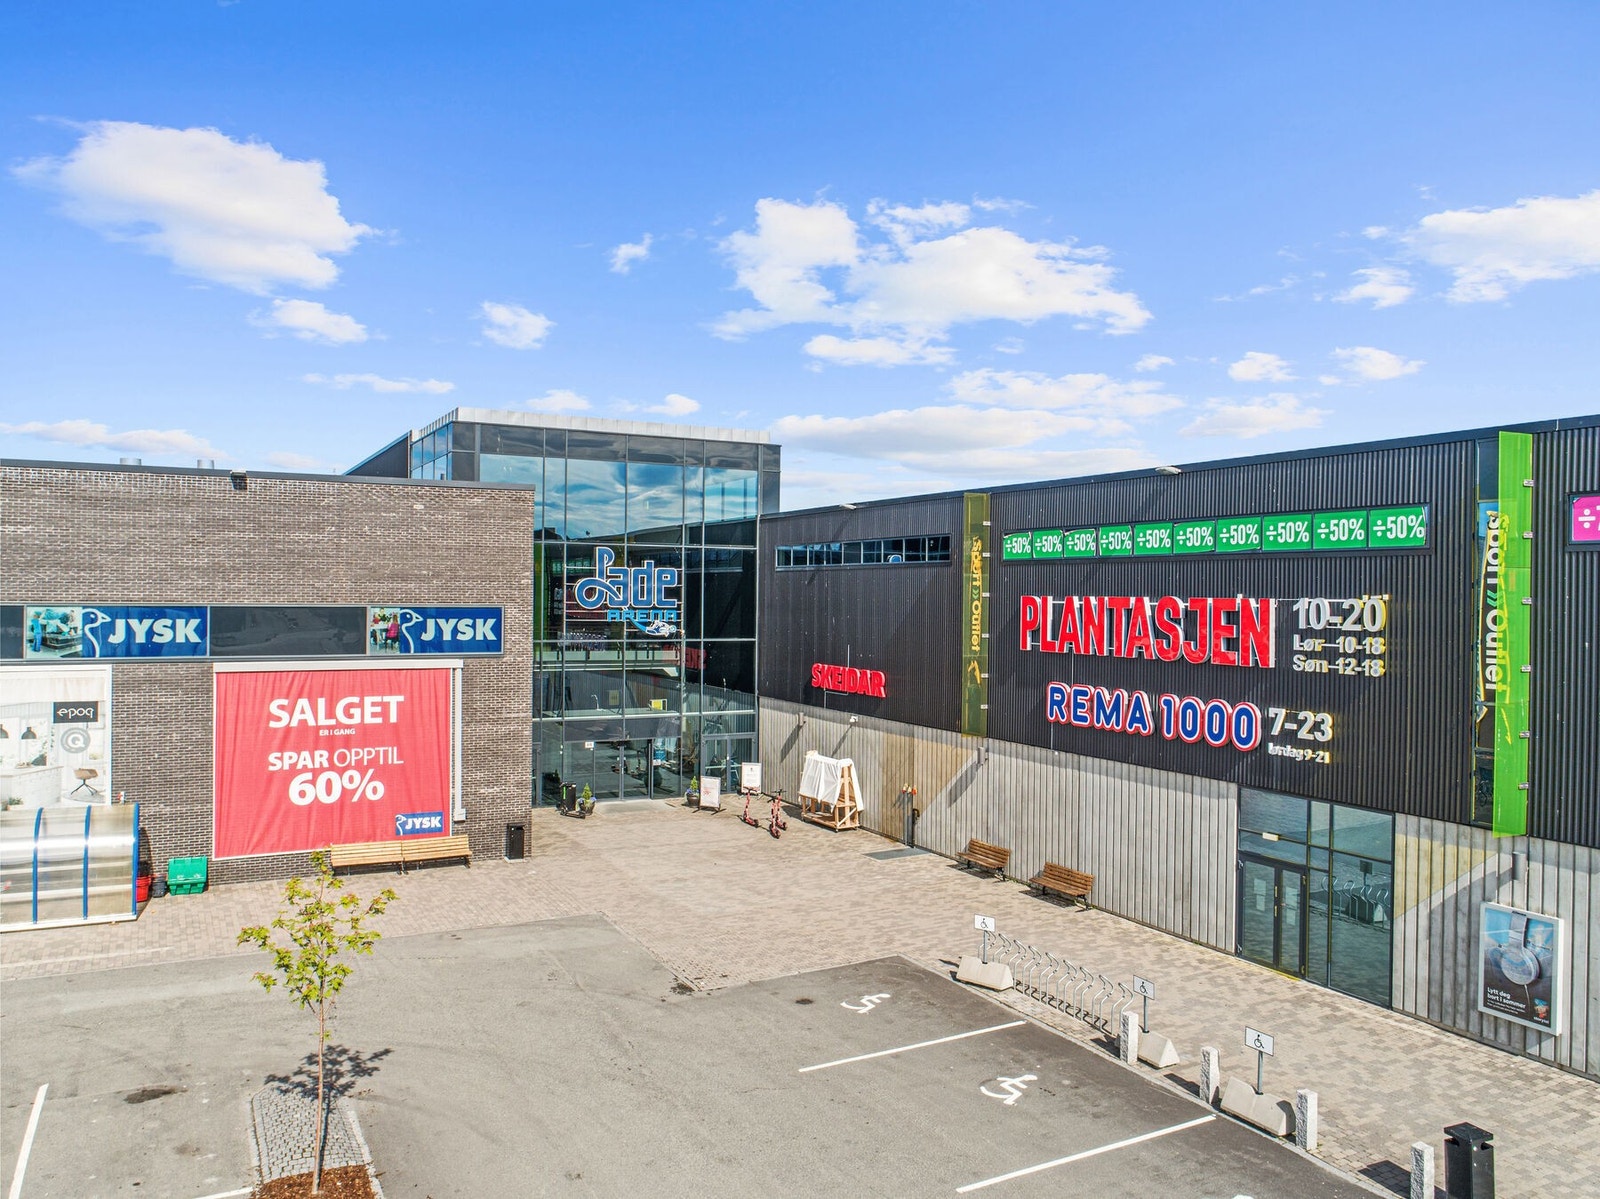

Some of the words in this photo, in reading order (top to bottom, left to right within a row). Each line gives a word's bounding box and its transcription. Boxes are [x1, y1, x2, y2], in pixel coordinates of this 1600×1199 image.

[607, 609, 678, 623] ARENA
[1292, 597, 1387, 632] 10-20
[107, 618, 202, 644] JYSK
[420, 618, 497, 641] JYSK
[1019, 595, 1276, 669] PLANTASJEN
[1293, 634, 1326, 652] Lør
[1335, 636, 1386, 655] 10-18
[1485, 608, 1509, 692] Outlet
[1292, 654, 1329, 673] Søn
[1335, 657, 1386, 677] 12-18
[811, 662, 887, 699] SKEIDAR
[57, 707, 95, 719] epoq
[268, 695, 405, 728] SALGET
[1046, 681, 1156, 736] REMA
[1159, 692, 1262, 753] 1000
[1268, 707, 1333, 742] 7-23
[267, 750, 329, 771] SPAR
[333, 746, 404, 767] OPPTIL
[288, 768, 385, 806] 60%
[404, 815, 442, 830] JYSK
[1503, 999, 1526, 1009] sommer
